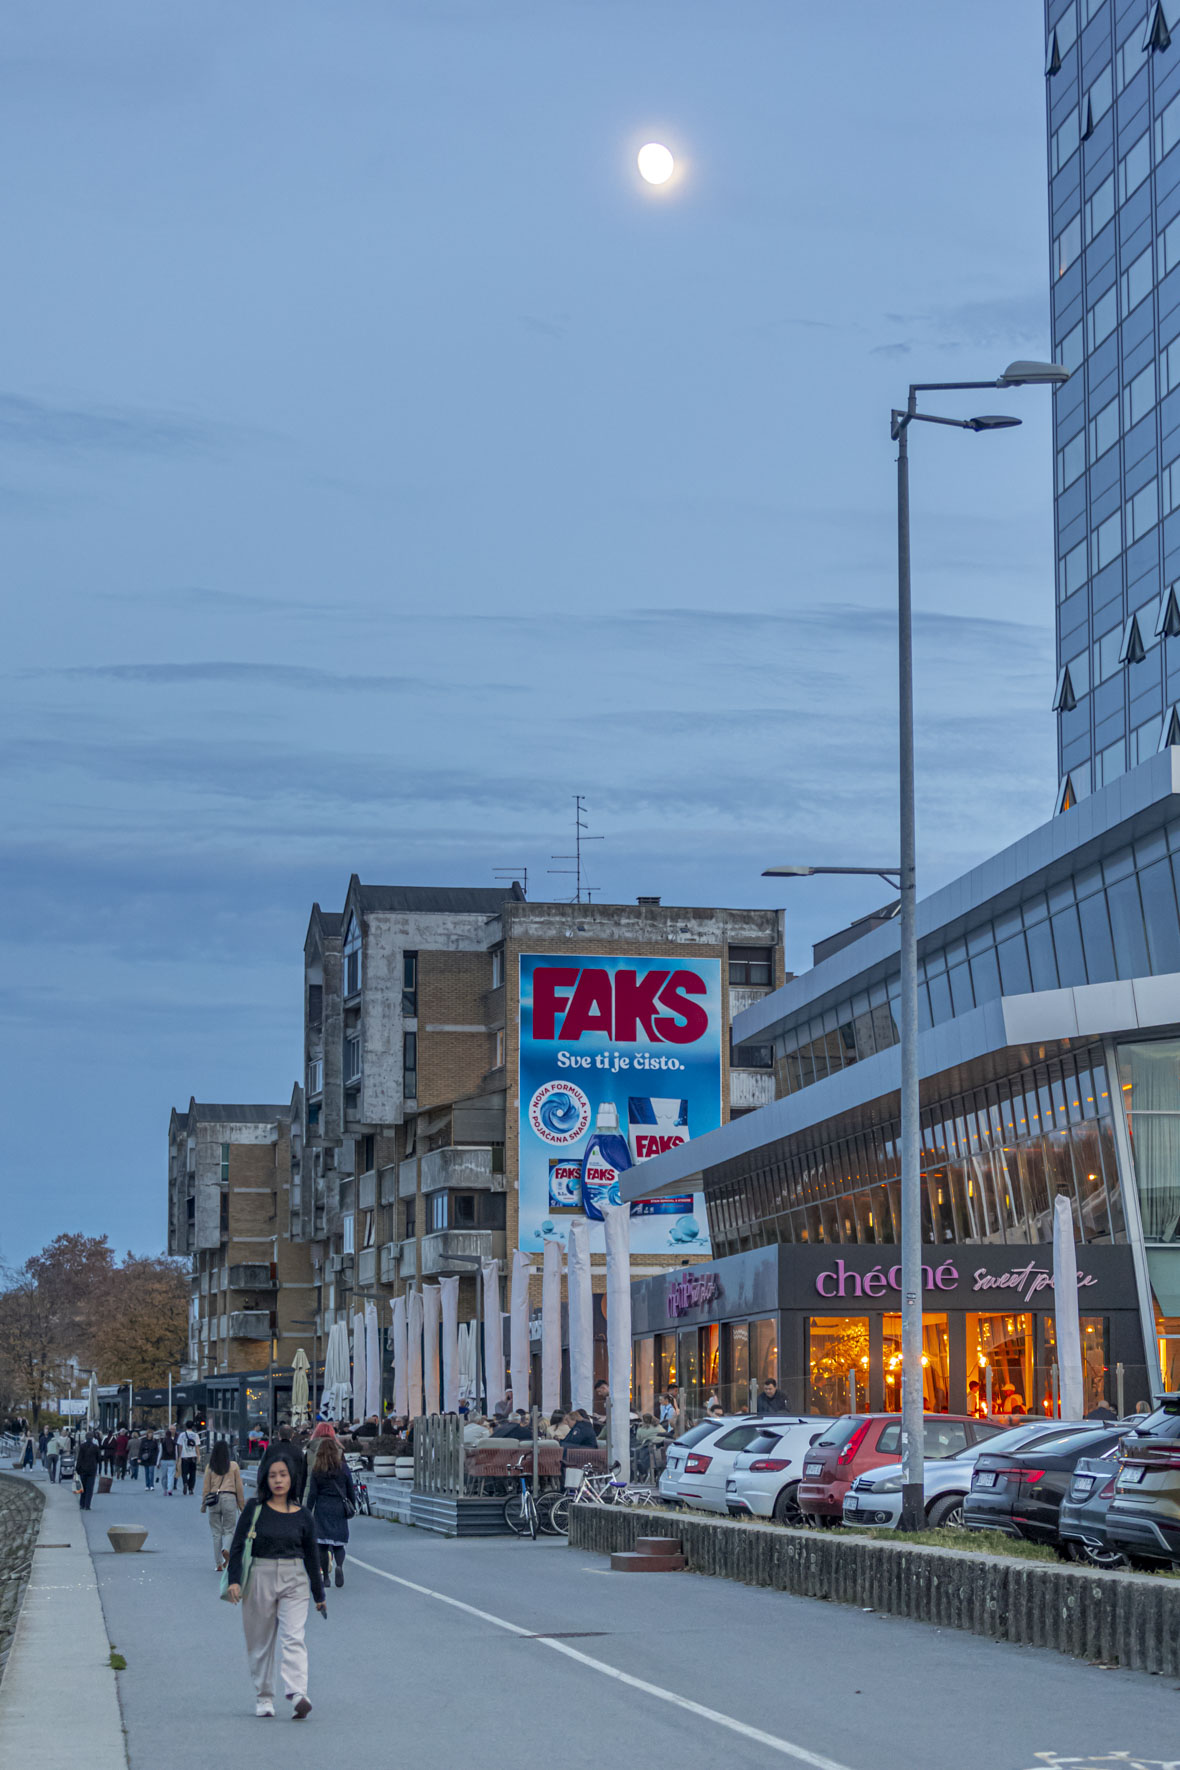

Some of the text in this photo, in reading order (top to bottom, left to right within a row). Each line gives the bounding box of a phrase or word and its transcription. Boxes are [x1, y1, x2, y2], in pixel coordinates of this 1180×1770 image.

[532, 967, 709, 1044] FAKS
[557, 1051, 685, 1073] Sve ti je čisto.
[532, 1083, 587, 1109] NOVA FORMULA
[532, 1115, 588, 1143] POJAČANA SNAGA
[555, 1167, 581, 1180] FAKS
[587, 1167, 615, 1181] FAKS
